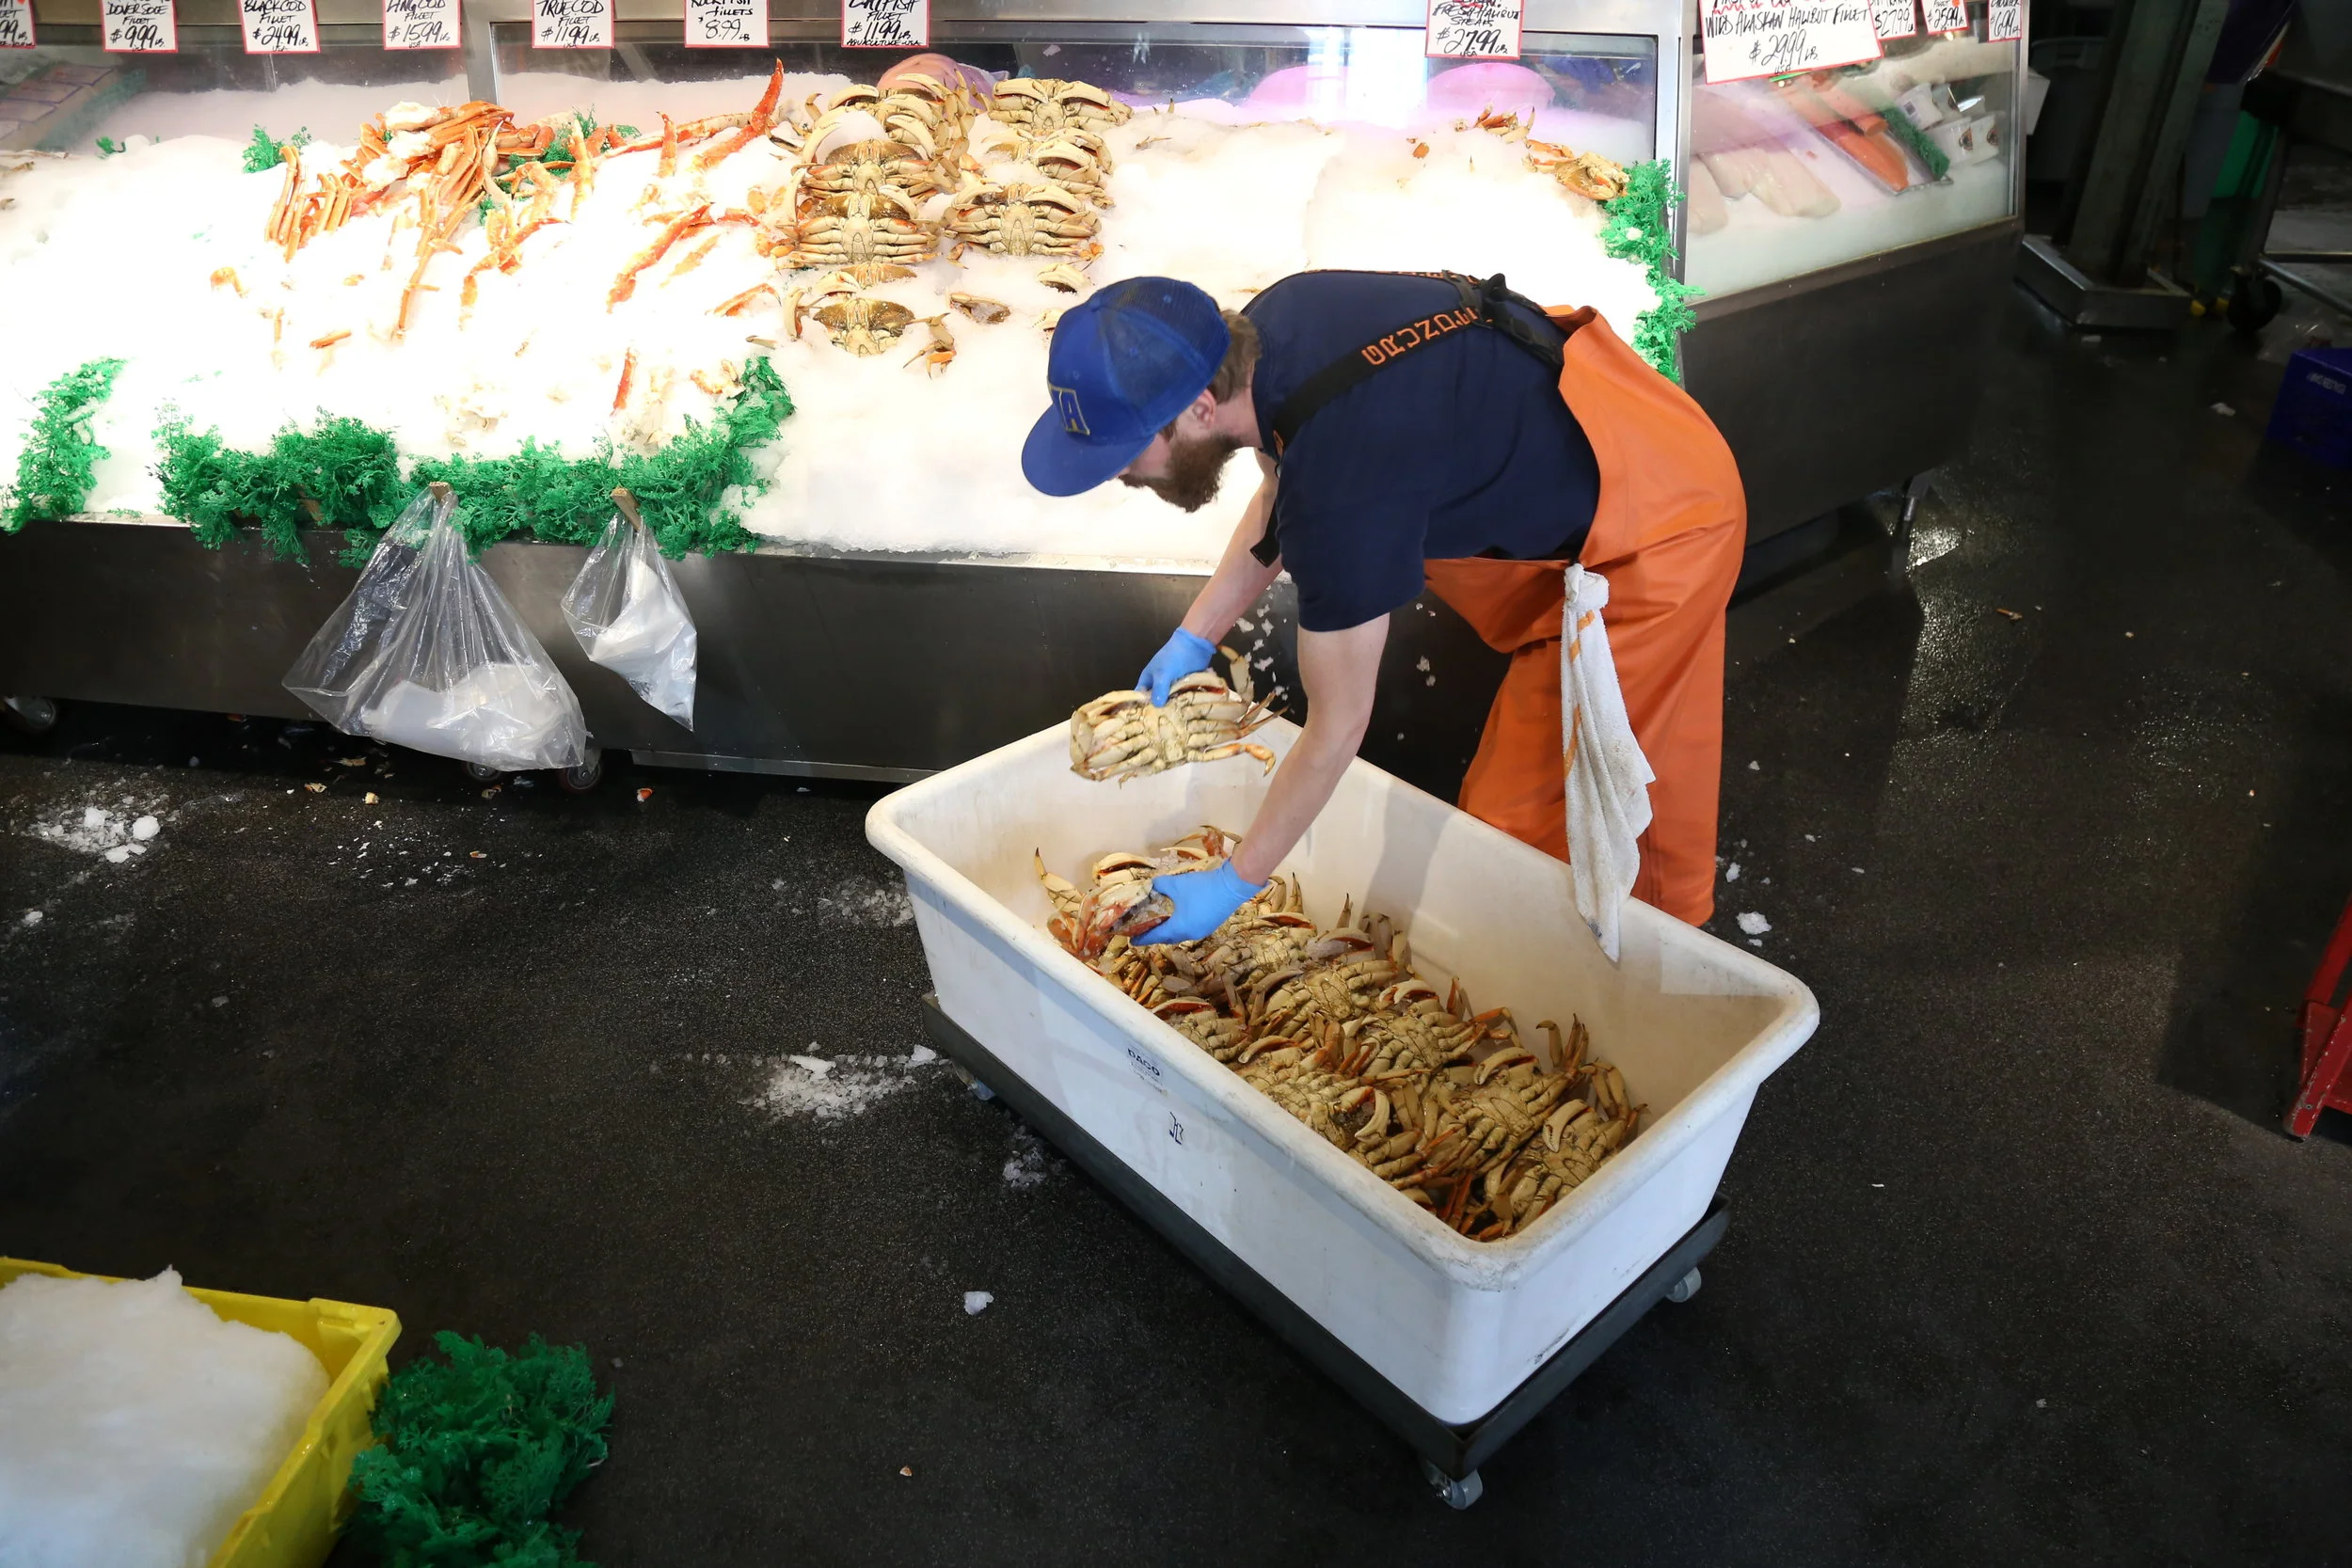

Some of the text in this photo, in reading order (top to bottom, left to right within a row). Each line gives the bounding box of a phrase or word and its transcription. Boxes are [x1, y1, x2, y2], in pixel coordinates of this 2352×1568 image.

[105, 2, 140, 15] DOVER
[281, 0, 307, 11] COD
[536, 0, 604, 18] TRUE COD
[1706, 12, 1733, 38] WILD
[1736, 9, 1783, 36] ALASKAN
[1788, 6, 1834, 28] HALIBUT
